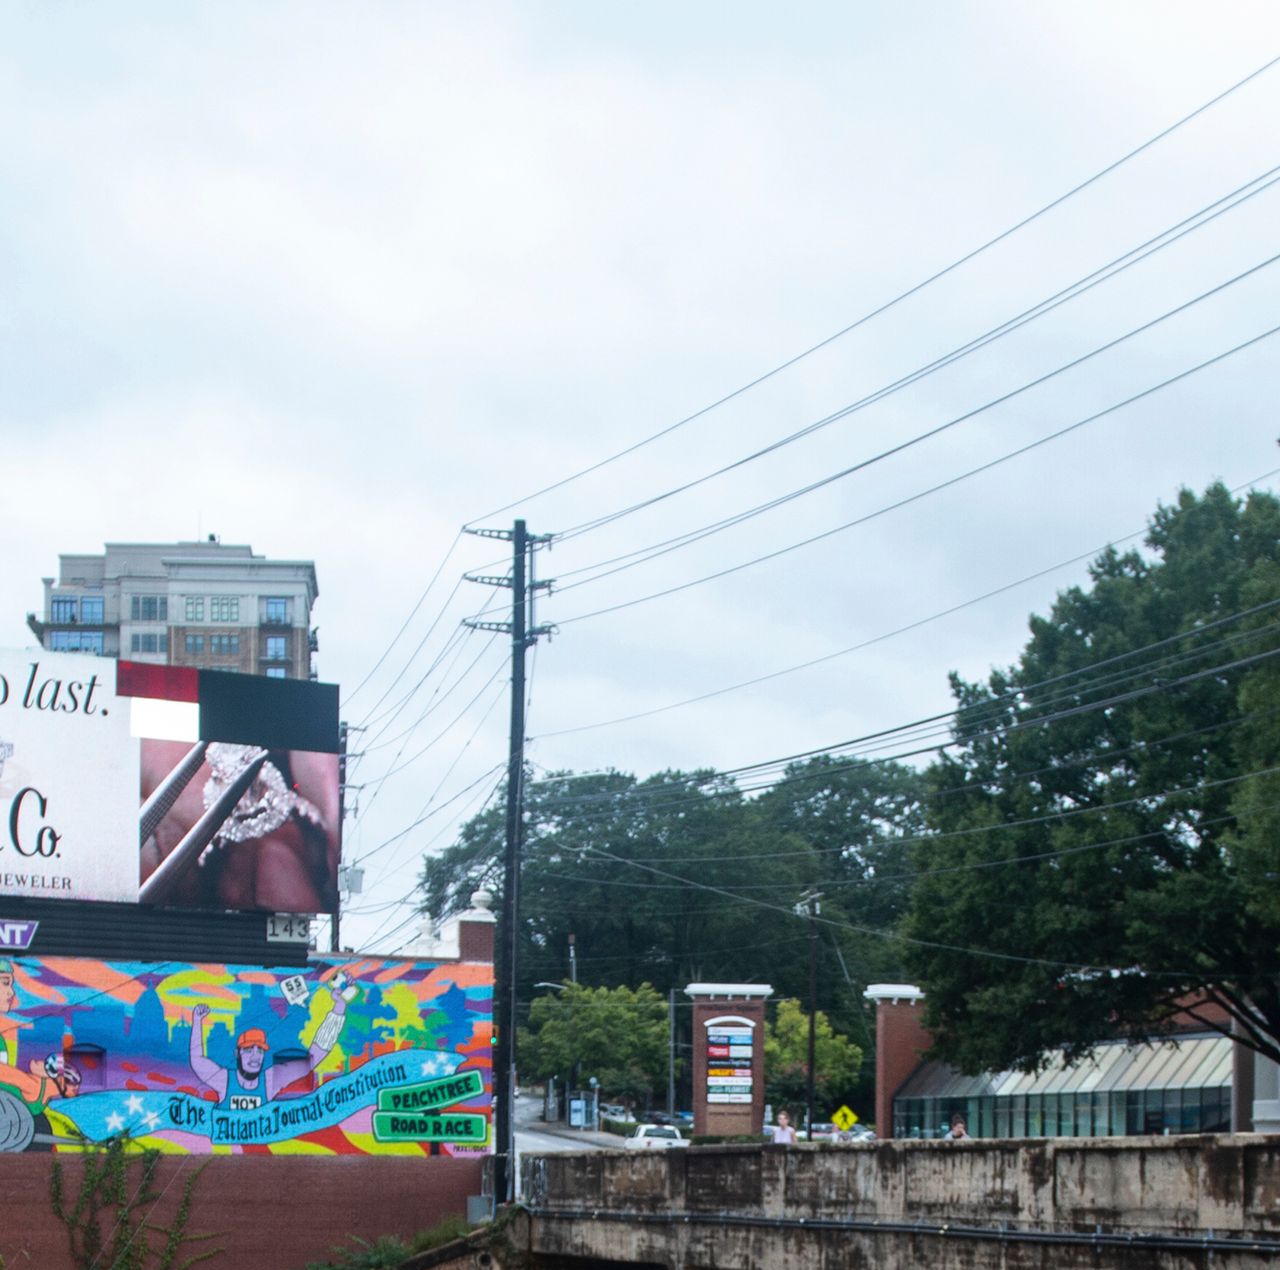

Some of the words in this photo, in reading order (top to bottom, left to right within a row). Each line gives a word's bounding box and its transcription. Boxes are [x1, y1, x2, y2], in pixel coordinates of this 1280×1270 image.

[22, 661, 109, 716] last.
[9, 787, 62, 858] Co.
[269, 918, 308, 938] 143
[231, 1097, 258, 1110] 404
[392, 1076, 474, 1109] PEACHTREE
[168, 1096, 205, 1129] The
[215, 1115, 272, 1141] Atlanta
[390, 1116, 429, 1135] ROAD
[431, 1119, 474, 1136] RACE
